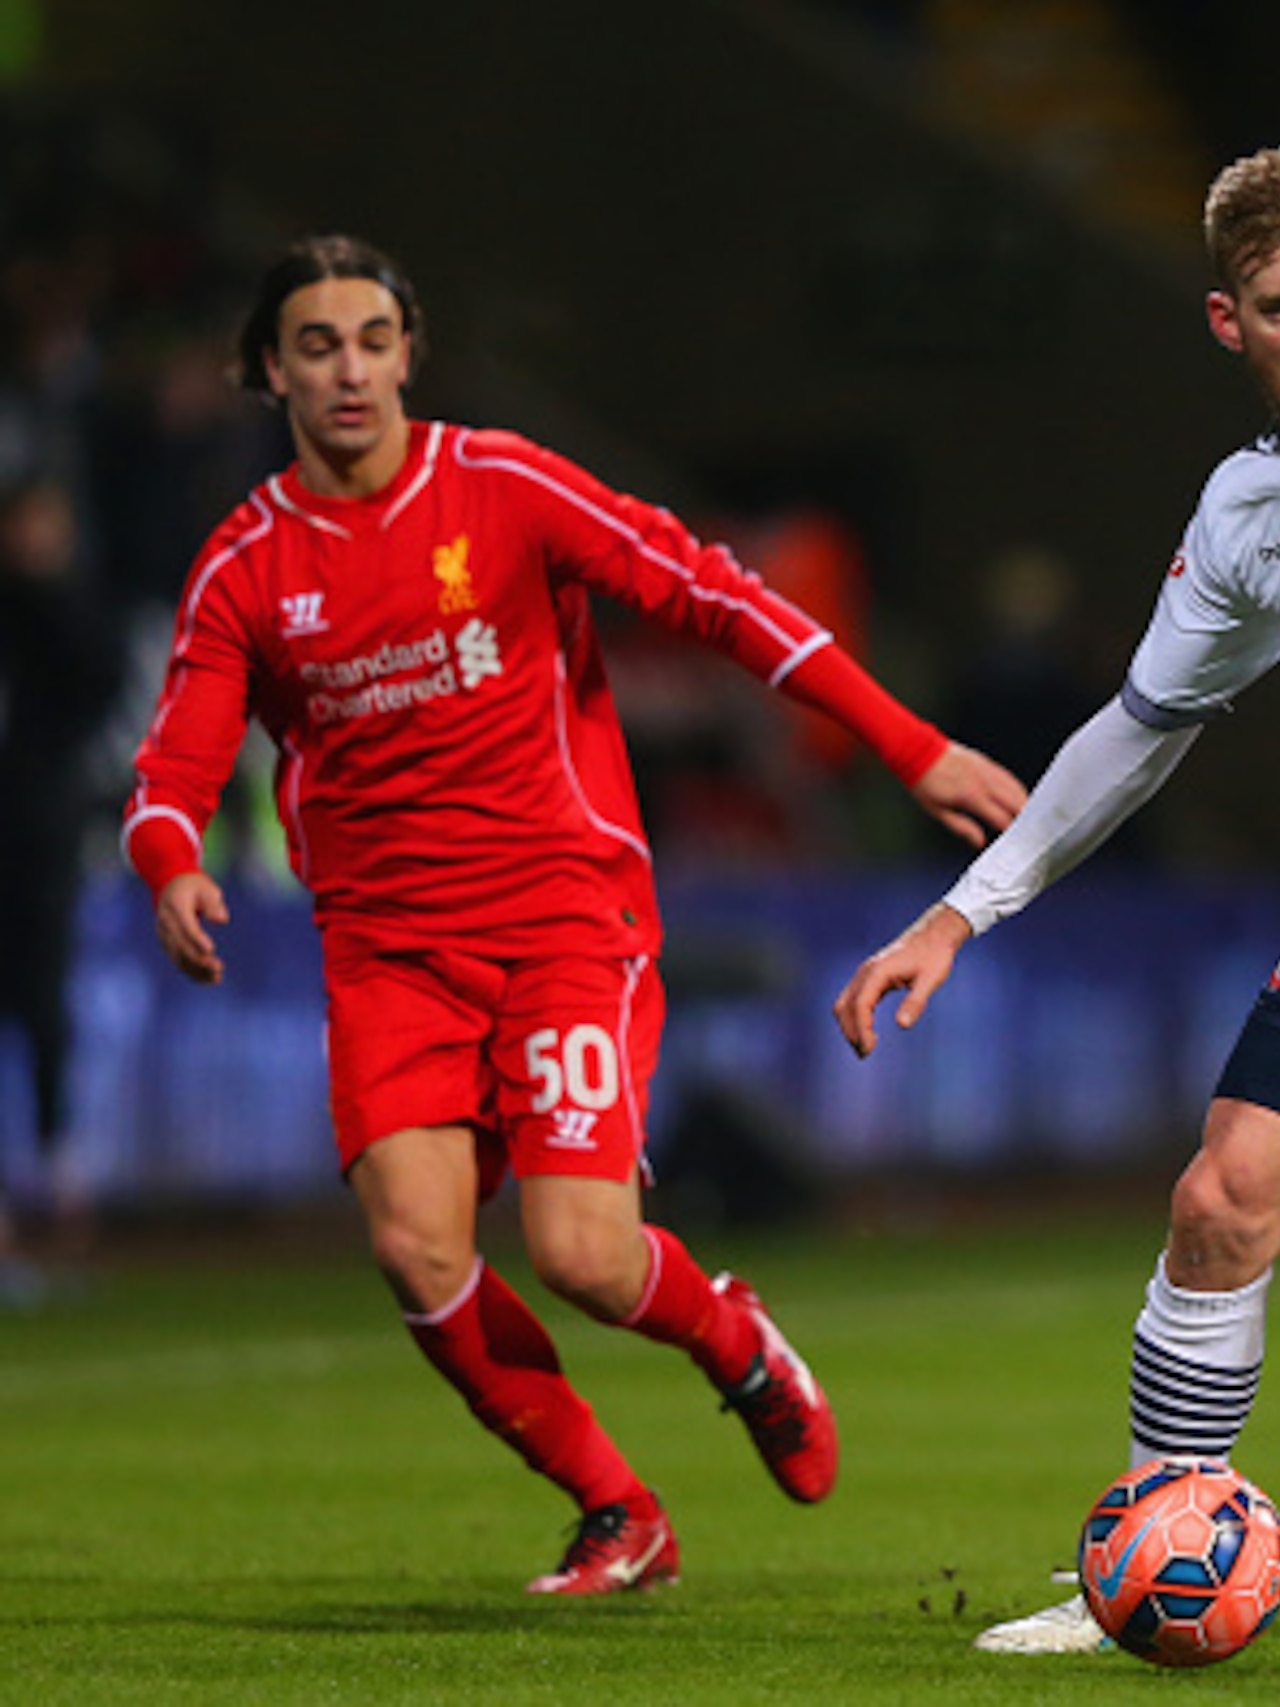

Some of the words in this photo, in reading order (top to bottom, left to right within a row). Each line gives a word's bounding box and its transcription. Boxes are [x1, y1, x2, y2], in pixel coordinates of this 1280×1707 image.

[301, 628, 448, 688] Standard
[309, 664, 457, 723] Chartered
[525, 1023, 619, 1115] 50
